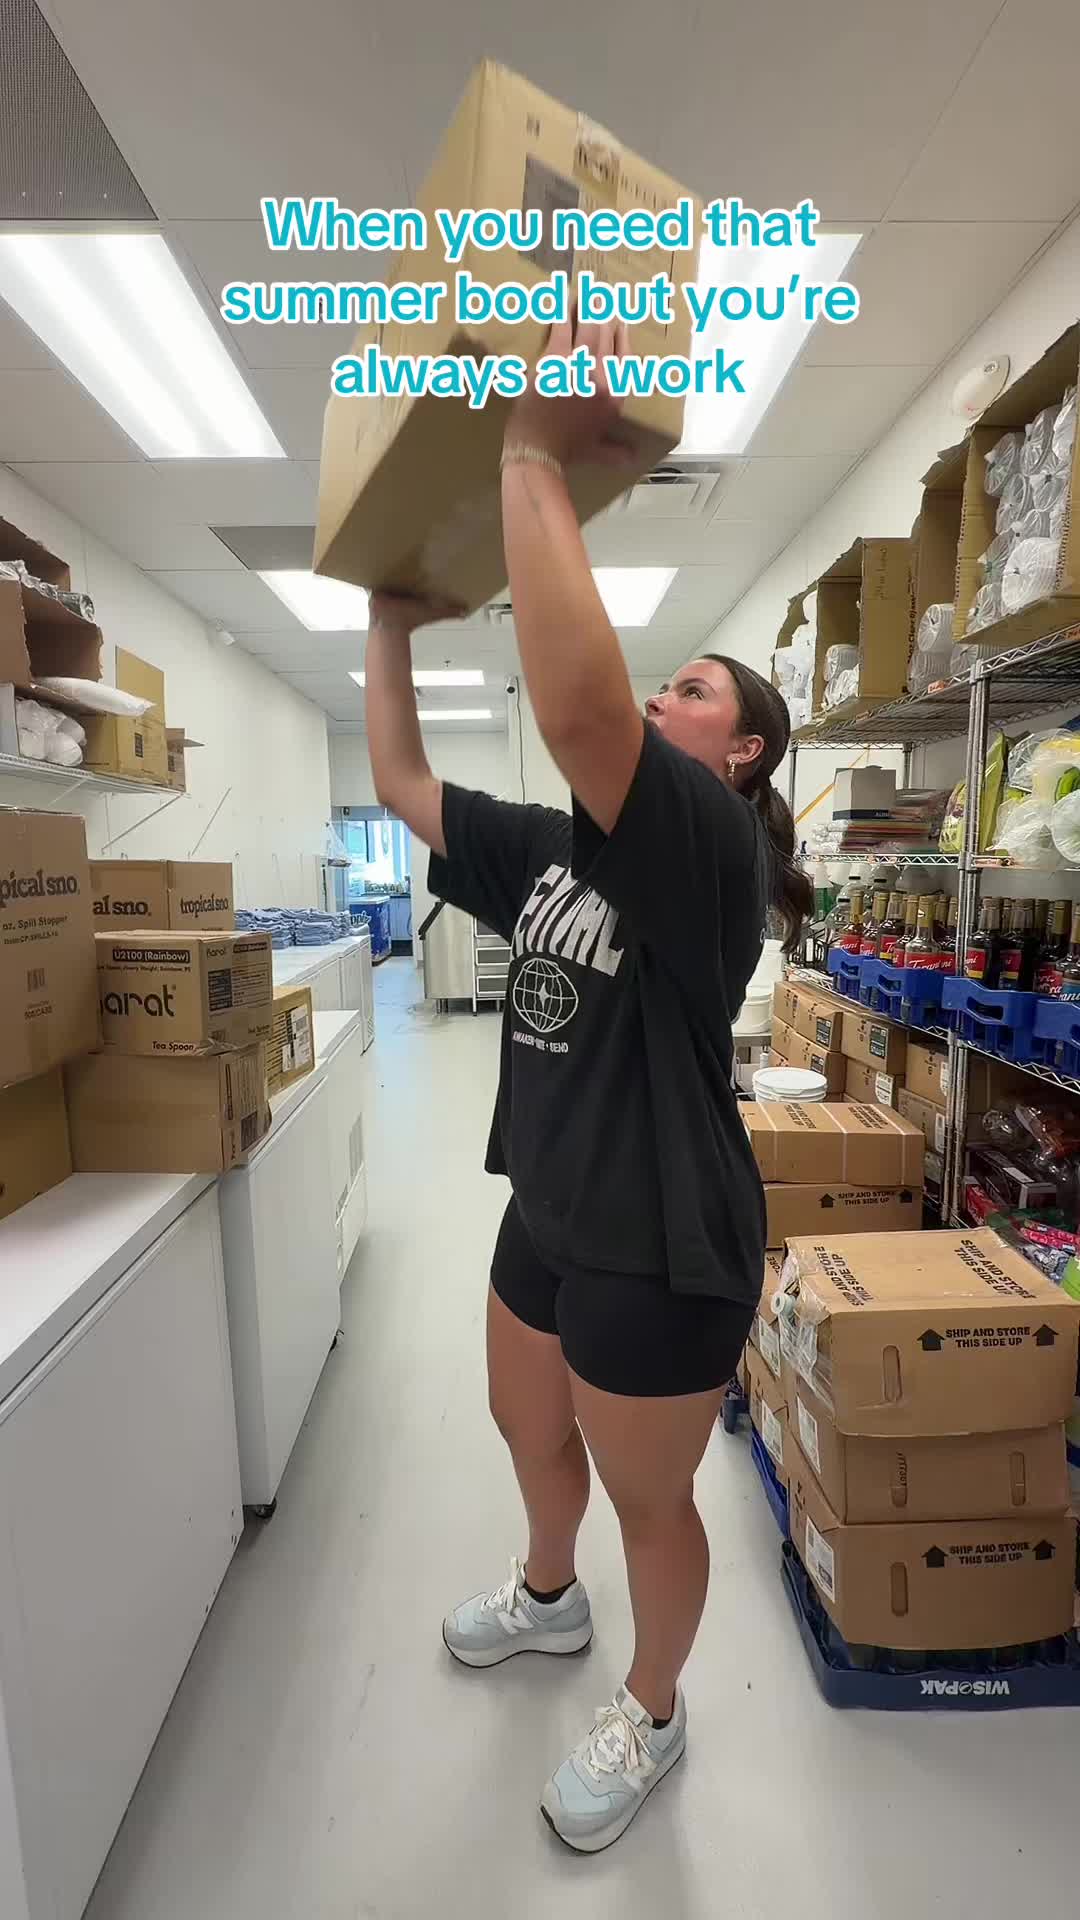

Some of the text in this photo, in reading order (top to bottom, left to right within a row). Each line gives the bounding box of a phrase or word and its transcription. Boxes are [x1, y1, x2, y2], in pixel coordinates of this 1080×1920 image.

[46, 875, 77, 896] sno
[112, 902, 149, 915] sno
[114, 950, 190, 962] U2100 (Rainbow)
[152, 1041, 194, 1052] Tea Spoon
[814, 1246, 837, 1277] STORE
[832, 1253, 847, 1267] UP
[954, 1247, 1013, 1296] THIS SIDE UP
[961, 1239, 1037, 1299] SHIP AND STORE
[831, 1276, 850, 1291] AND
[839, 1268, 860, 1286] SIDE
[945, 1326, 1031, 1338] SHIP AND STORE
[955, 1338, 1023, 1348] THIS SIDE UP
[950, 1542, 1030, 1554] SHIP AND STORE
[958, 1553, 1023, 1565] THIS SIDE UP
